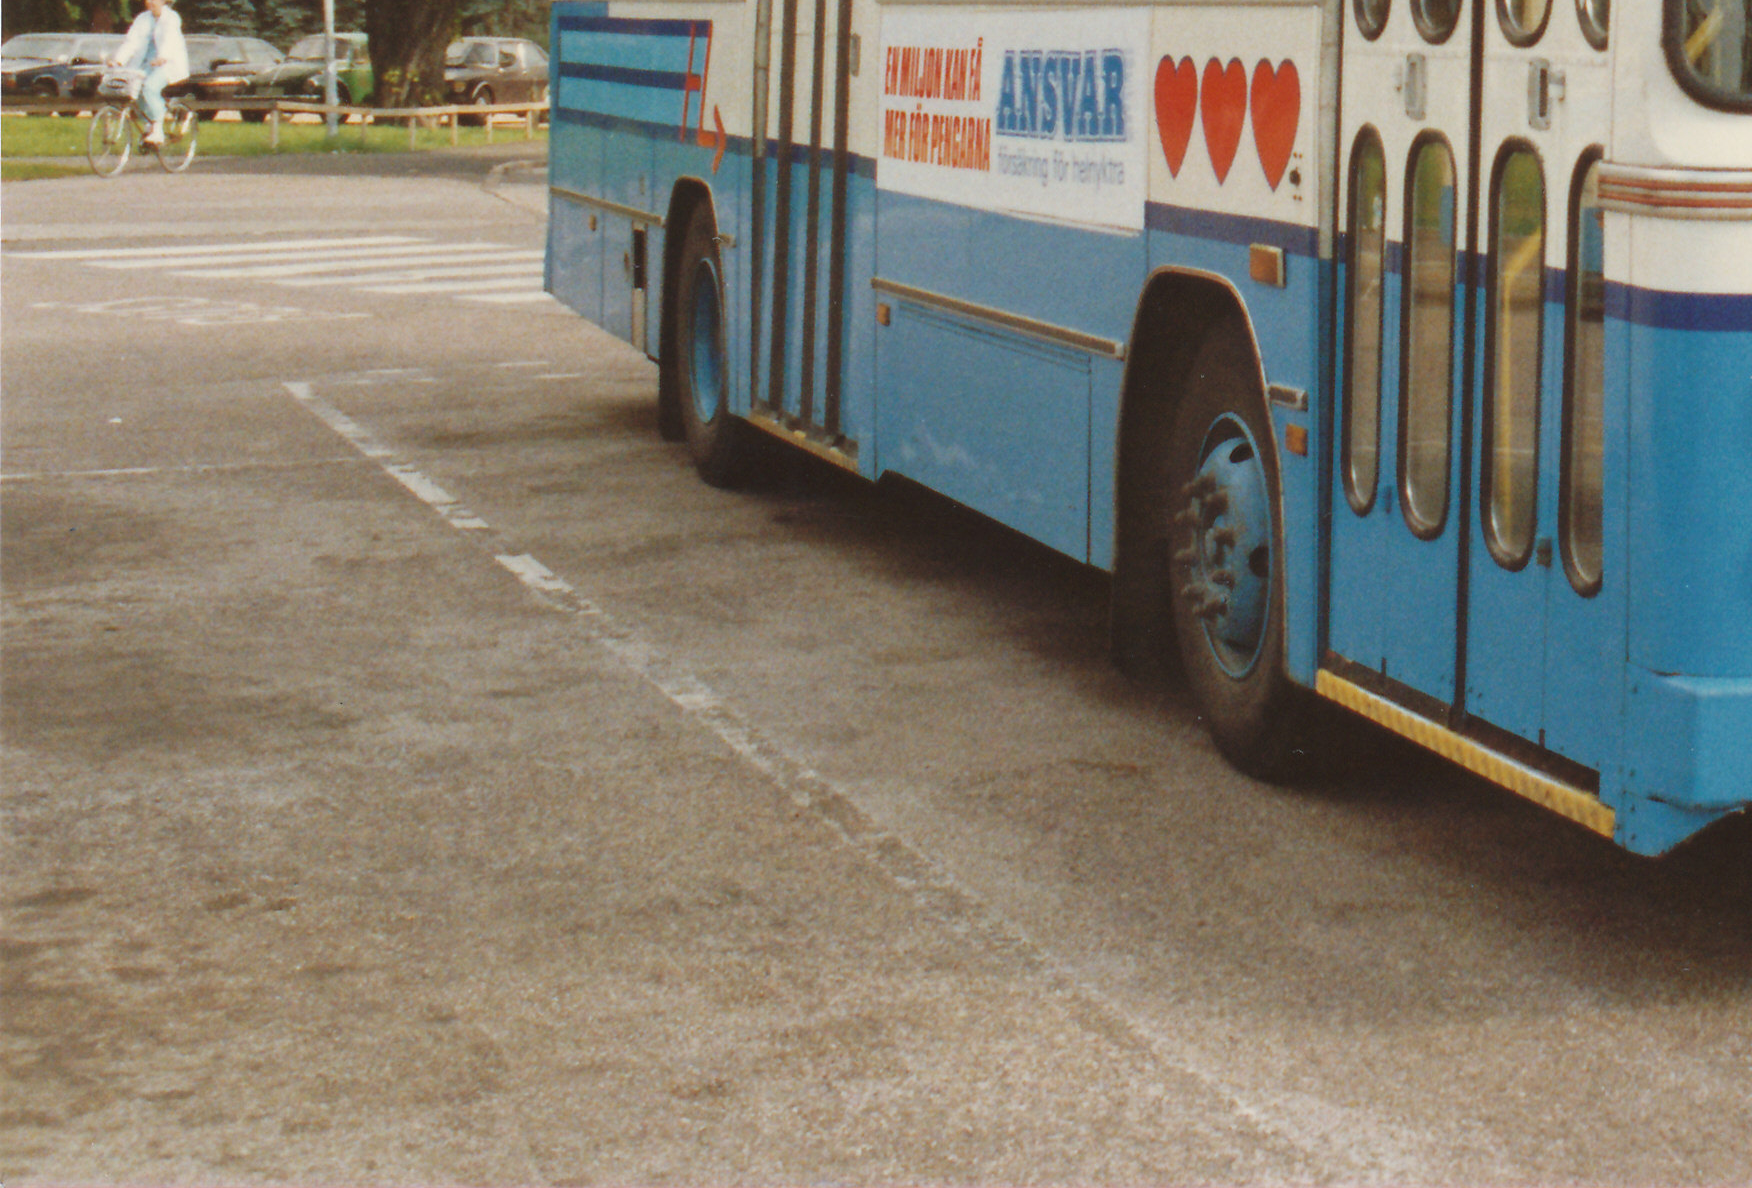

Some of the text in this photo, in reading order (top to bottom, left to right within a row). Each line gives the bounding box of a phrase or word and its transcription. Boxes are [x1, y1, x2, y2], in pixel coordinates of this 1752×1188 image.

[885, 37, 983, 101] EN MILJON KAN FÅ
[996, 49, 1126, 143] ANSVAR
[884, 103, 991, 172] MER FÖR PENGARNA
